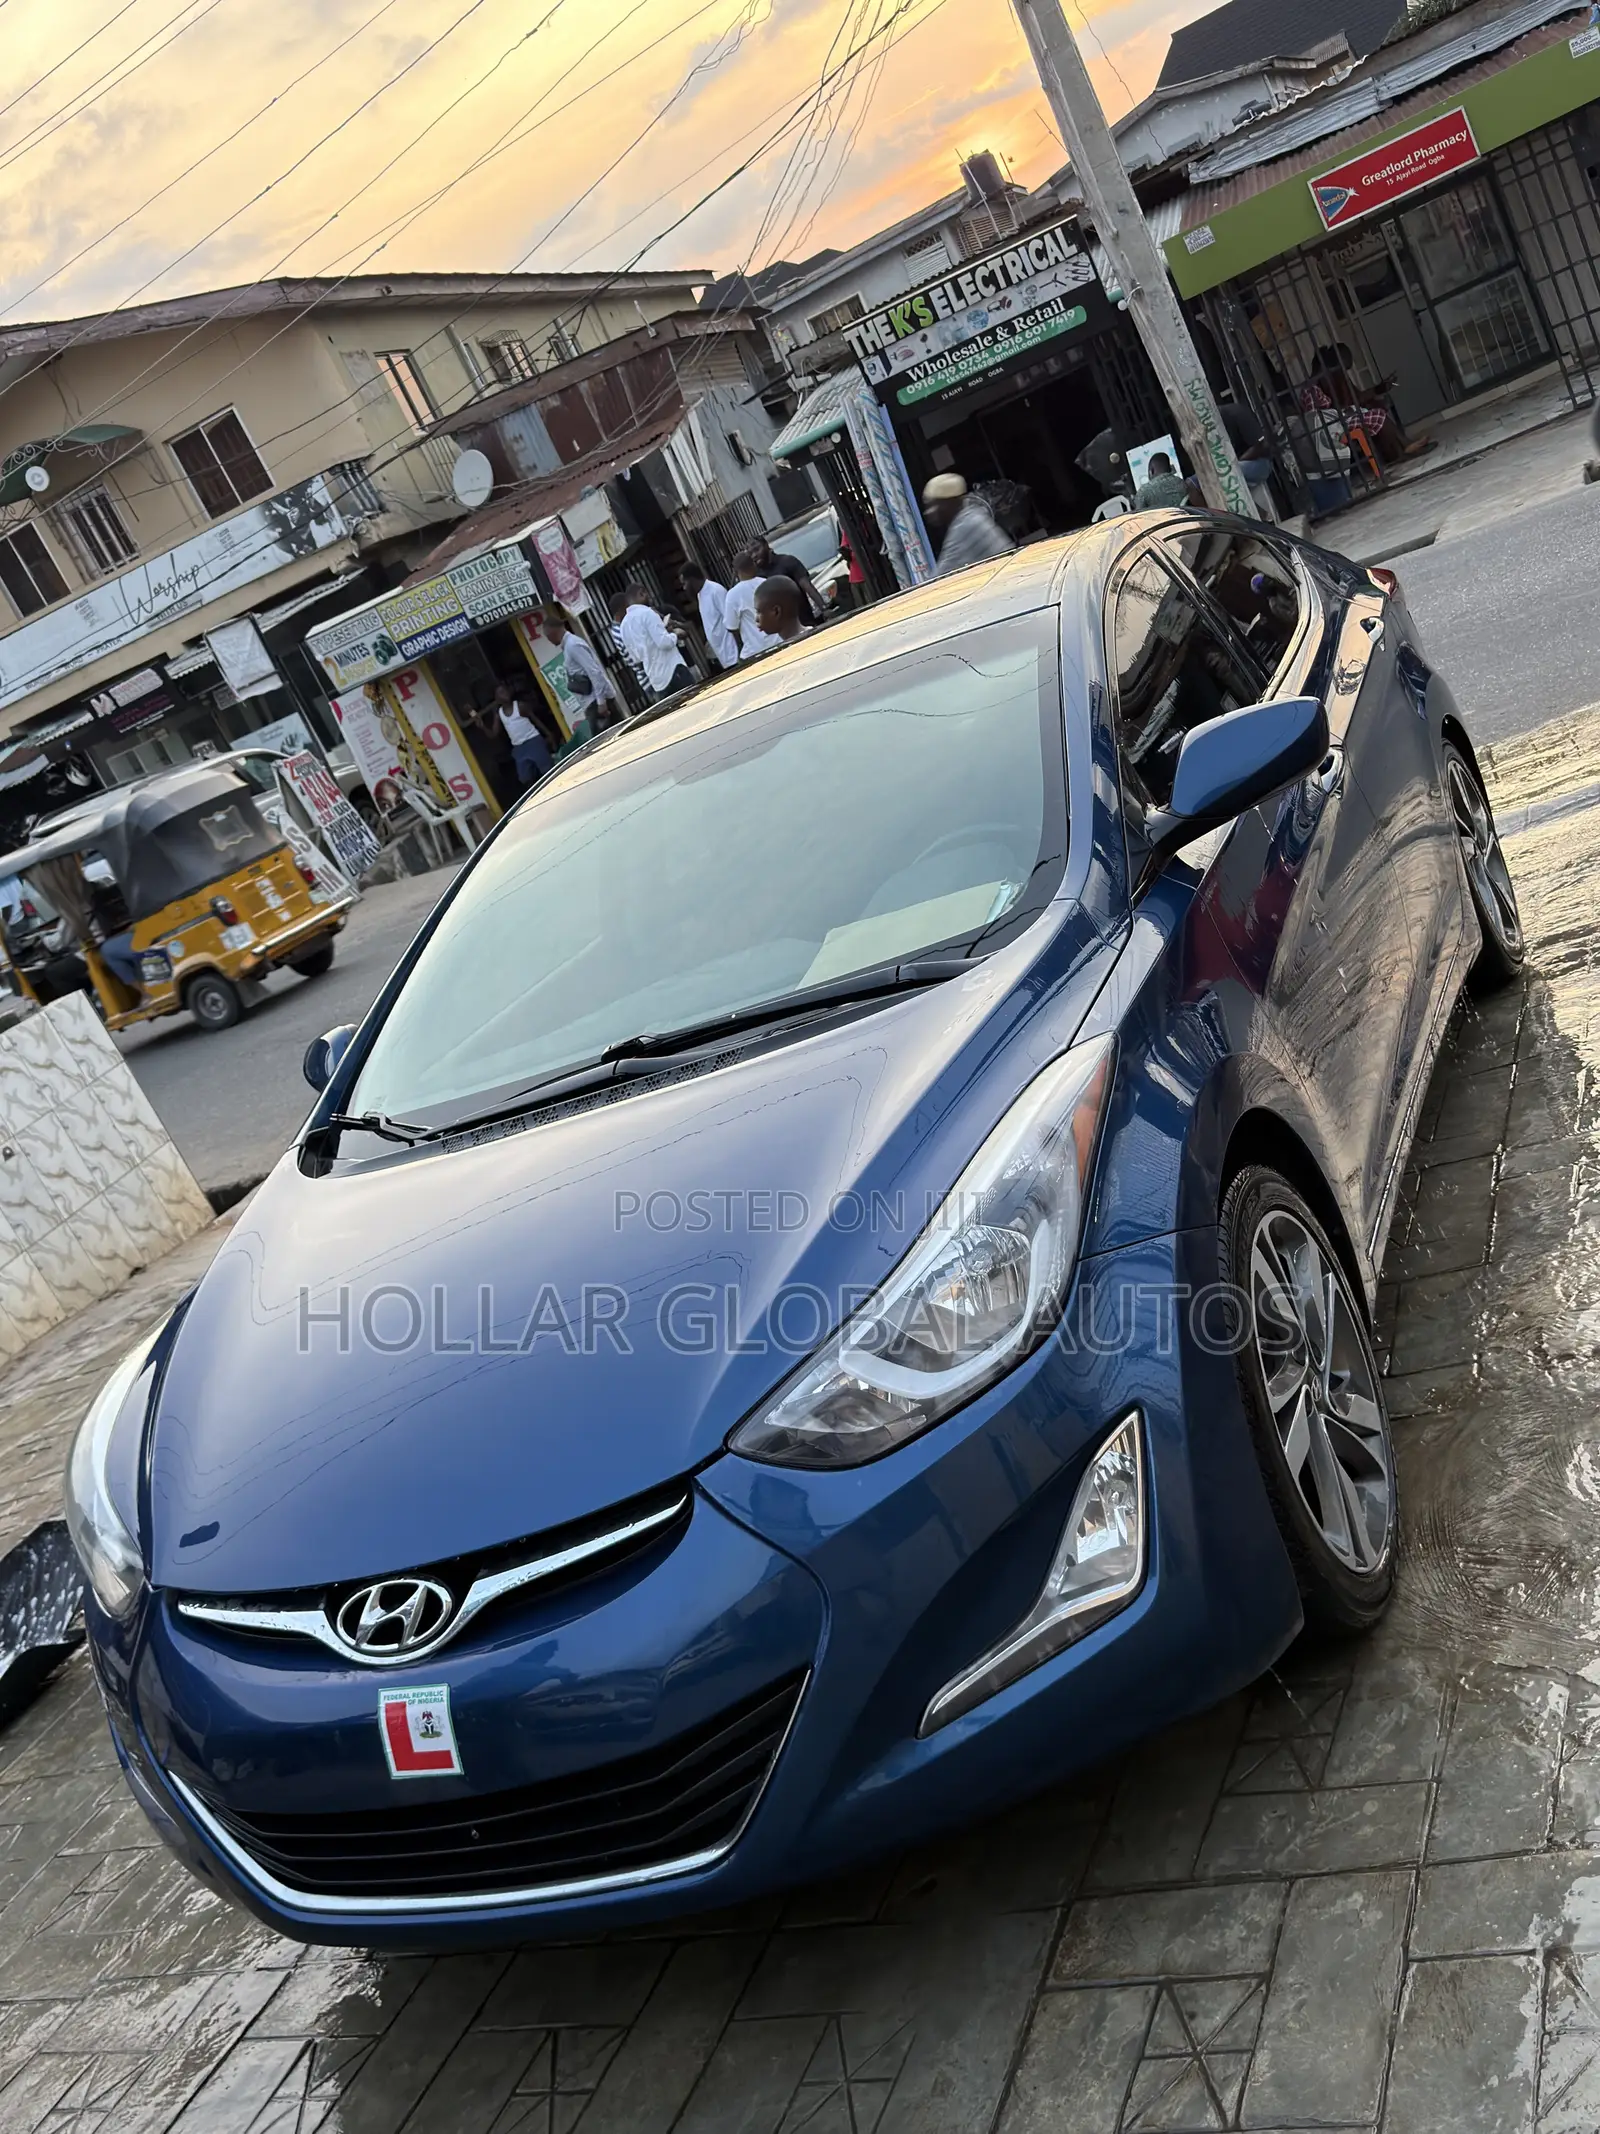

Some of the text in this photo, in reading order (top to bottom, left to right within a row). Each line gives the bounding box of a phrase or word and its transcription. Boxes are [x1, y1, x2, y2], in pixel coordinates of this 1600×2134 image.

[1361, 130, 1468, 185] Greatlord Pharmacy
[1395, 170, 1411, 181] Ajayi
[1410, 162, 1426, 173] Road
[1428, 153, 1444, 164] Ogba
[843, 313, 896, 359] THE
[930, 228, 1077, 318] ELECTRICAL
[906, 298, 1064, 381] Wholesale & Retail
[906, 309, 1075, 395] 0916 419 0734 0916 601 7419
[967, 376, 983, 387] ROAD
[988, 367, 1003, 377] OGBA
[449, 547, 518, 585] PHOTOCOPY
[457, 564, 526, 602] LAMINATION
[119, 553, 200, 626] Worship
[380, 598, 415, 623] COLOUR
[421, 581, 450, 603] BLACK
[469, 581, 529, 616] SCAN & SEND
[312, 611, 381, 654] TYPESETTING
[390, 596, 459, 639] PRINTING
[401, 616, 470, 657] GRAPHIC DESIGN
[323, 654, 347, 688] 2
[334, 642, 369, 669] MINUTES
[383, 1690, 444, 1701] FEDERAL REPUBLIC
[385, 1701, 454, 1772] L
